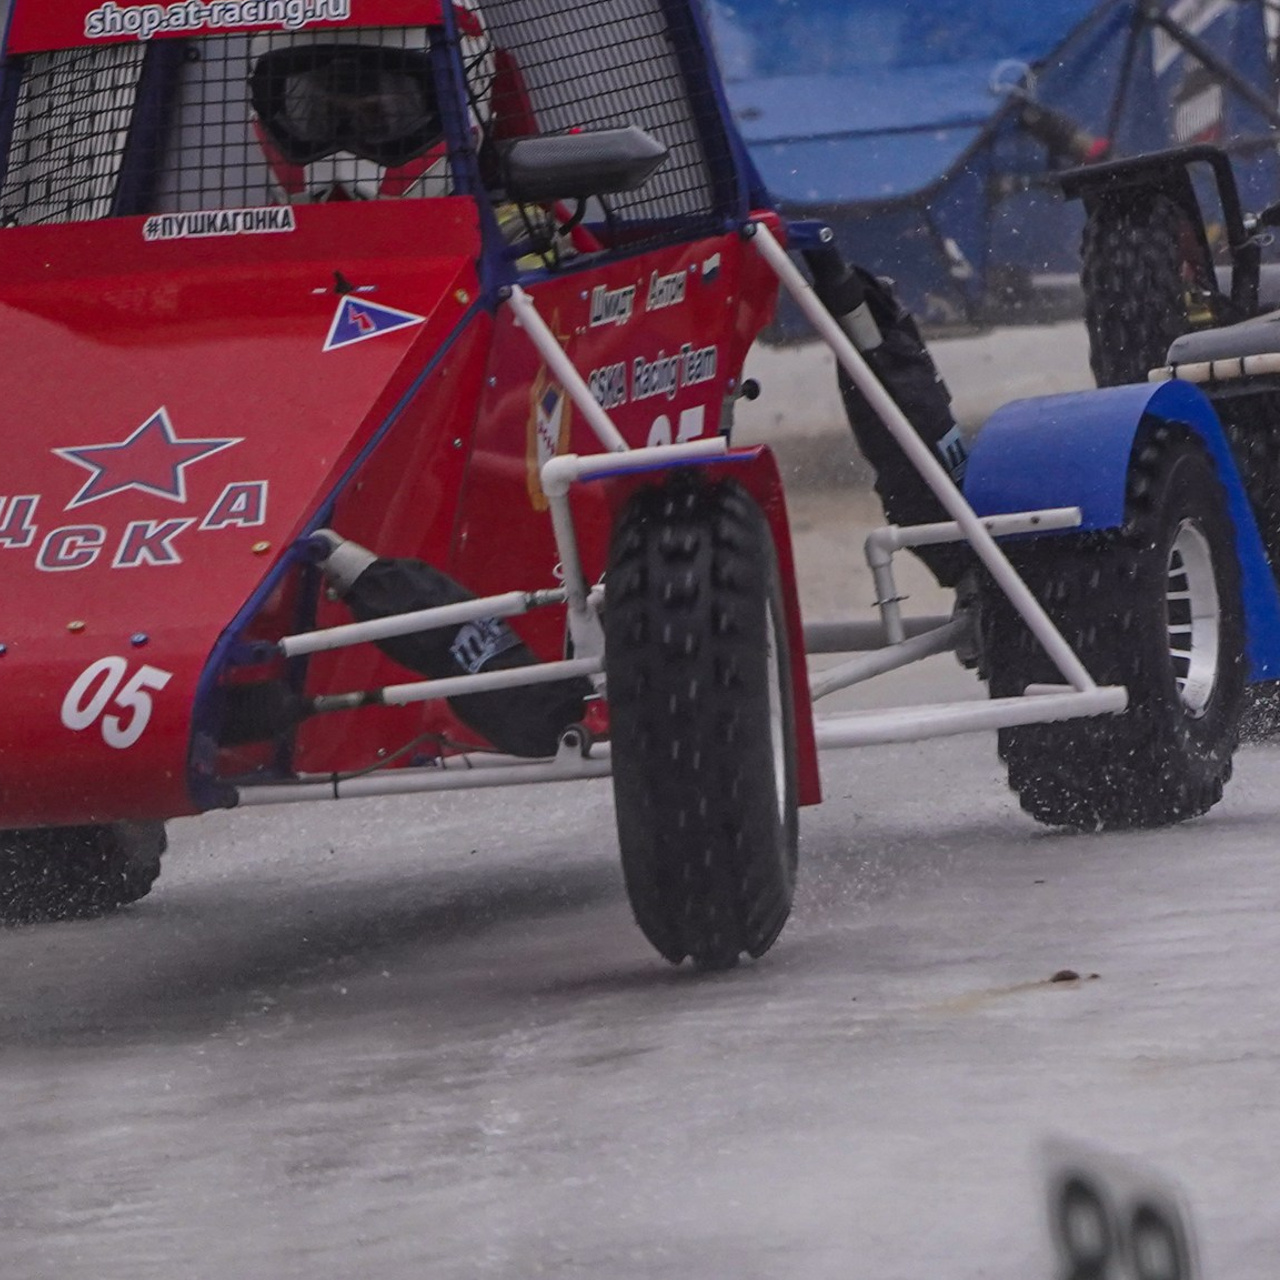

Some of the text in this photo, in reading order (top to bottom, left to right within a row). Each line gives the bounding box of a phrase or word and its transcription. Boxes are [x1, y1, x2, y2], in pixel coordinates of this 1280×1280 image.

[146, 207, 292, 239] #ПУШКАГОНКА
[679, 342, 717, 388] Team
[60, 656, 173, 749] 05
